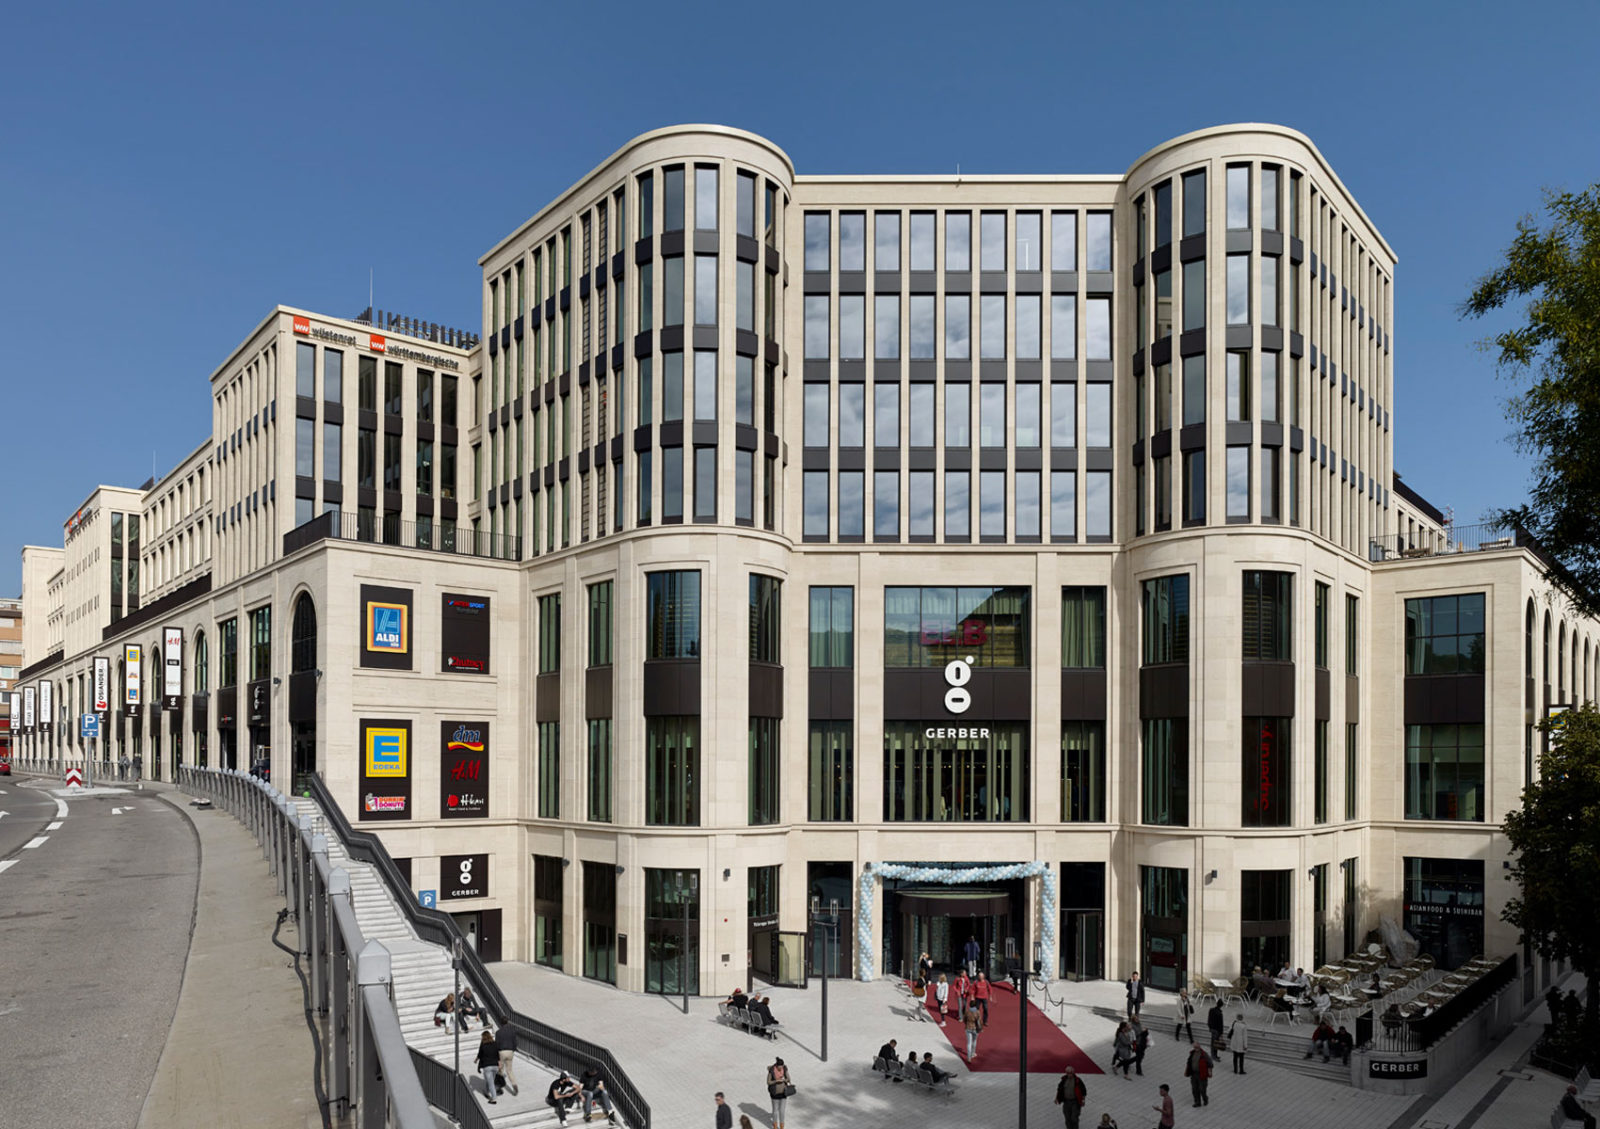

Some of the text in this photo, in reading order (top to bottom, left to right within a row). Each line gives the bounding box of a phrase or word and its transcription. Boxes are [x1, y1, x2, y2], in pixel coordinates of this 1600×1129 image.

[312, 326, 357, 346] wüstenrot
[387, 344, 459, 370] württembergische
[376, 633, 399, 642] ALDI
[84, 716, 96, 728] P
[453, 725, 480, 742] dm
[925, 728, 990, 739] GERBER
[450, 760, 481, 780] H&M
[424, 896, 432, 905] P
[1371, 1062, 1420, 1073] GERBER
